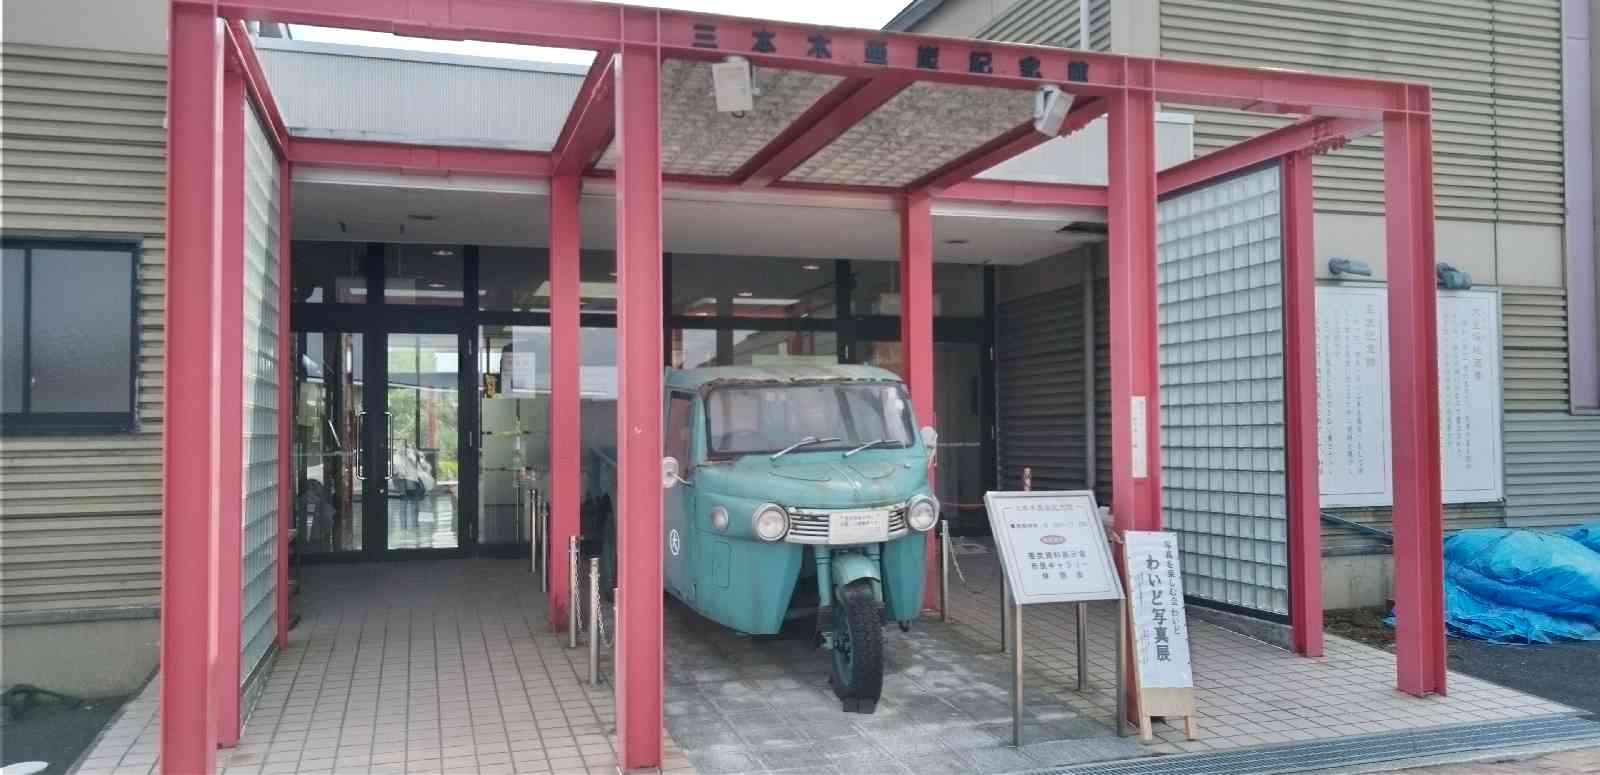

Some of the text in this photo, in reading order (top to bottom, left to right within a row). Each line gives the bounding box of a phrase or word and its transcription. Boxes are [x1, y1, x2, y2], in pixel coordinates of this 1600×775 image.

[1145, 555, 1171, 662] わいど写真展
